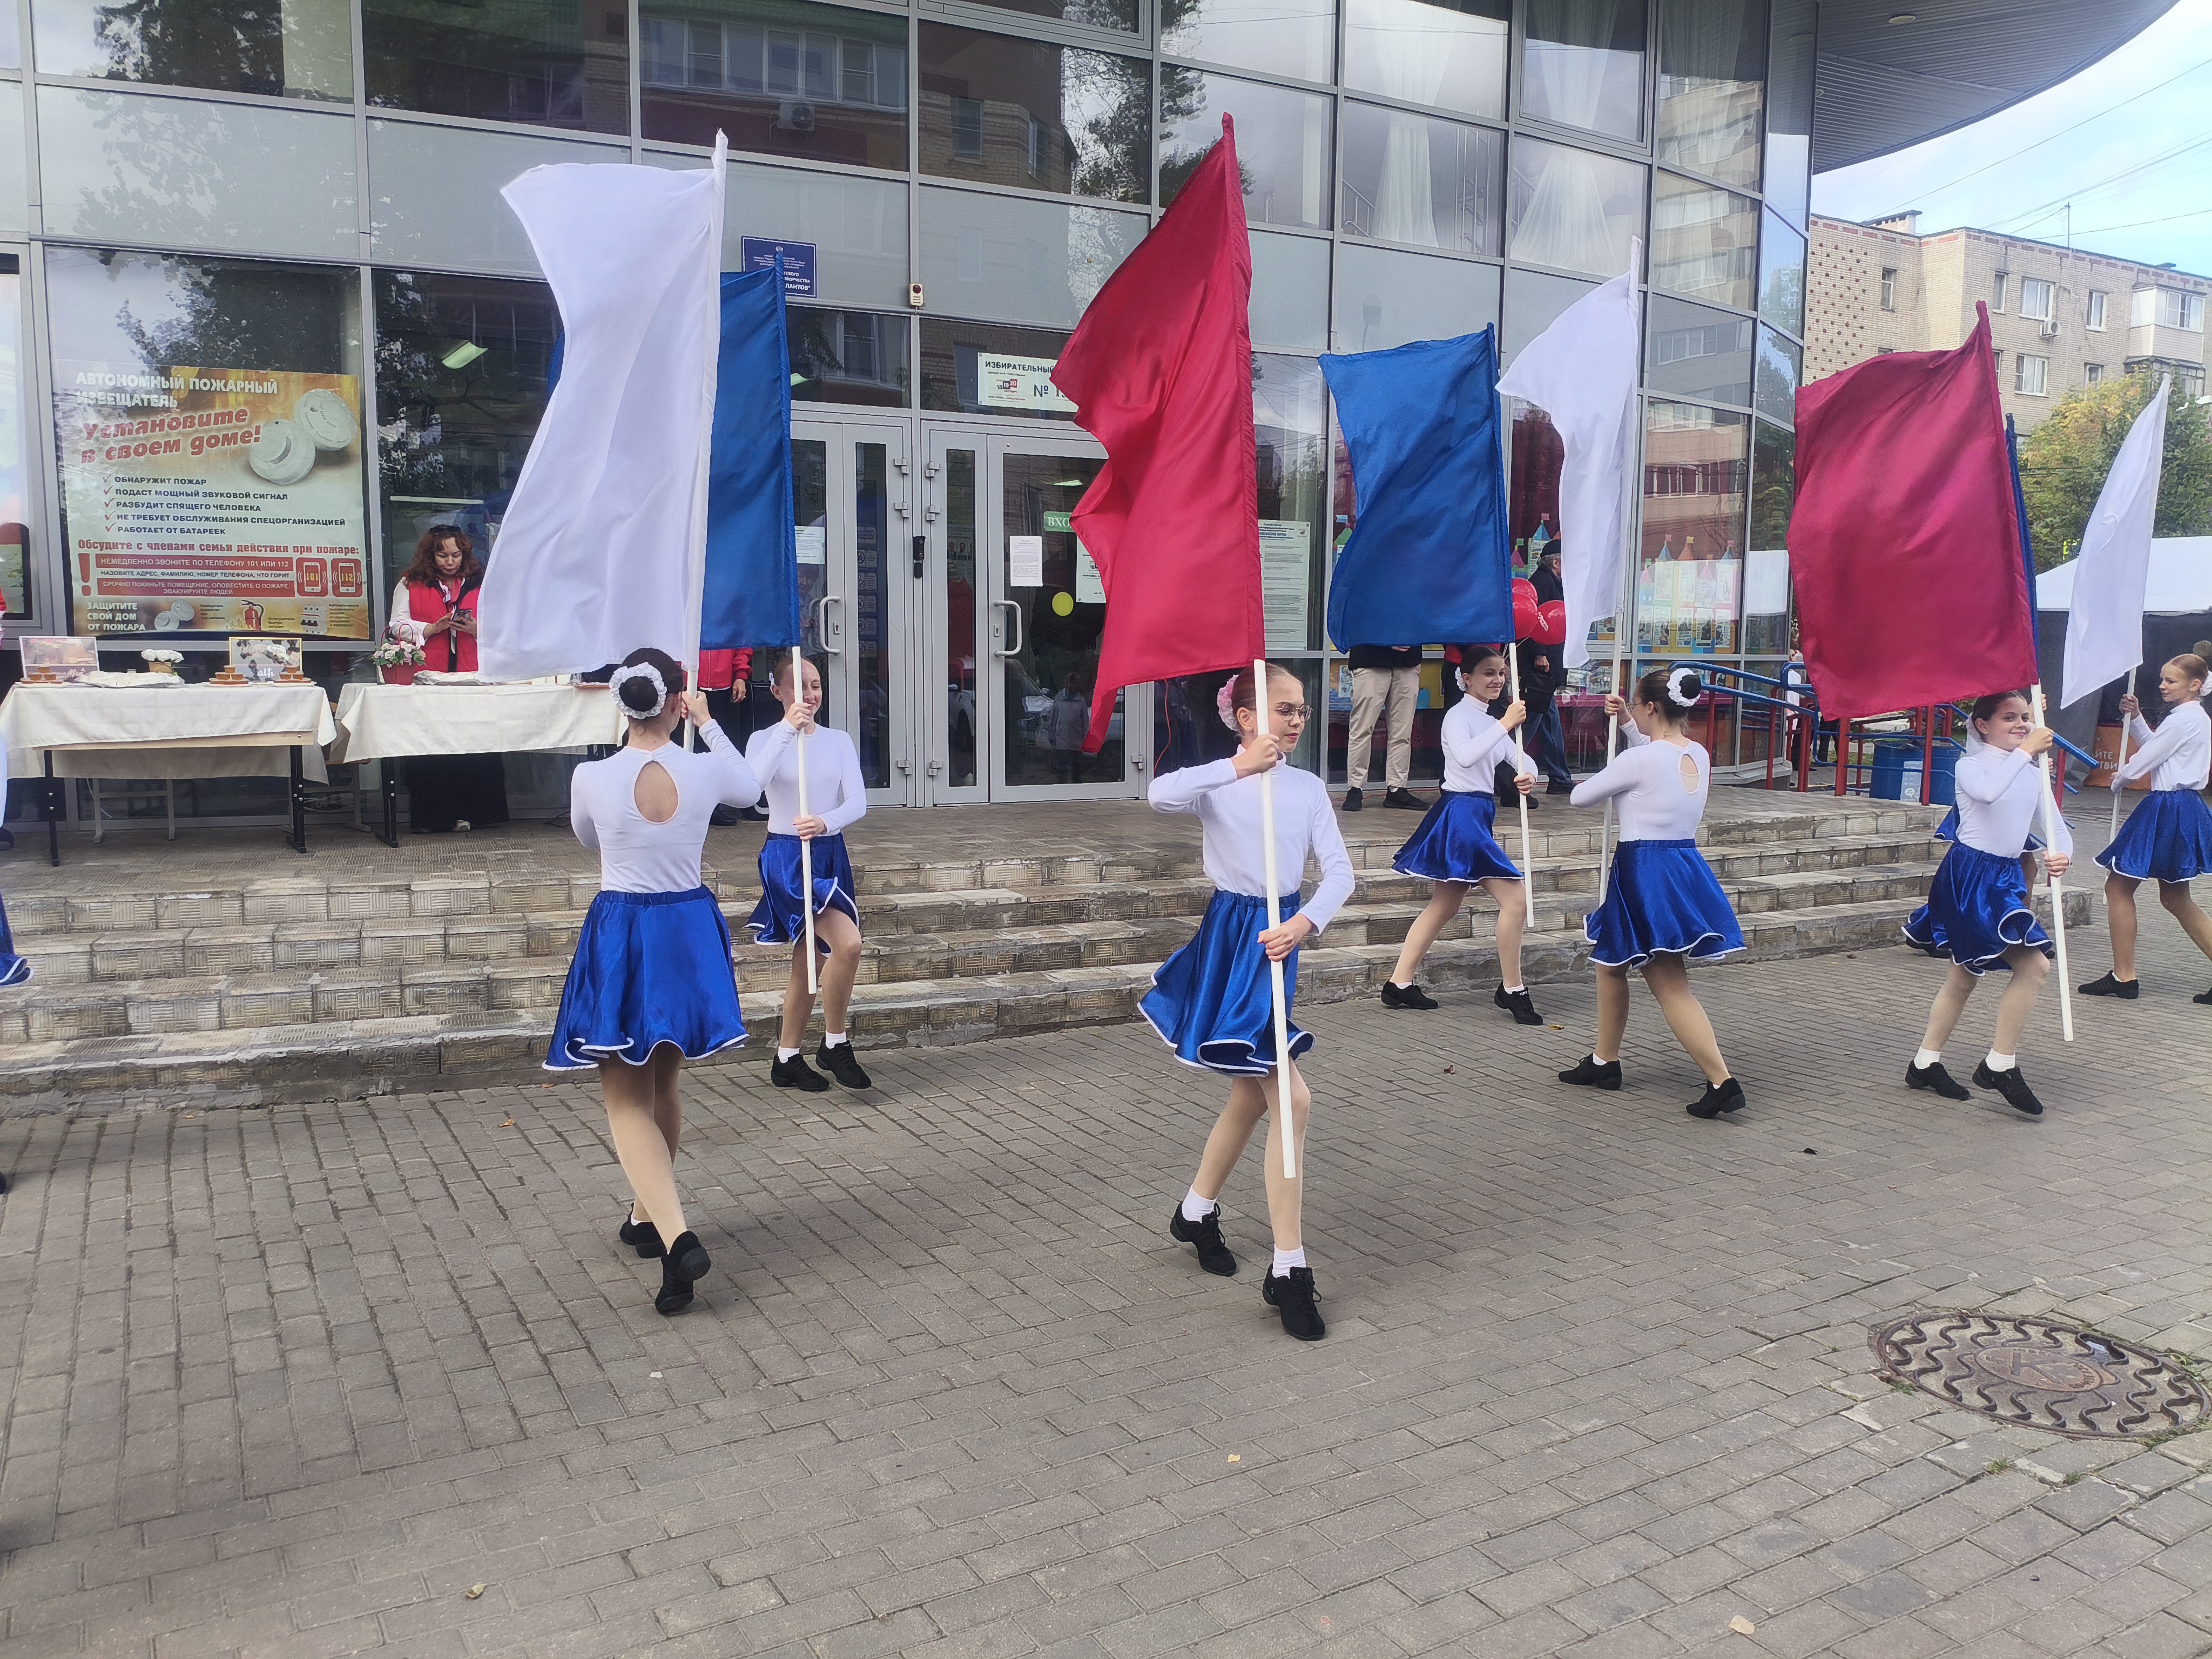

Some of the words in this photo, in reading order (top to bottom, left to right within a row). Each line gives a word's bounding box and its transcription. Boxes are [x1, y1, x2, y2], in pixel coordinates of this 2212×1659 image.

[76, 372, 184, 390] АВТОНОМНЫЙ
[190, 379, 278, 394] ПОЖАРНЫЙ
[77, 392, 178, 408] ИЗВЕЩАТЕЛЬ
[83, 409, 248, 440] Установите
[81, 448, 96, 463] в
[105, 439, 181, 461] своем
[190, 425, 261, 456] доме!
[114, 476, 171, 484] ОБНАРУЖИТ
[155, 490, 200, 498] МОЩНЫЙ
[251, 517, 346, 526] СПЕЦОРГАНИЗАЦИЕЙ
[1048, 517, 1072, 529] ВХО
[78, 539, 132, 551] Обсудите
[147, 543, 195, 551] членами
[199, 543, 232, 551] семьи
[237, 543, 288, 553] действия
[293, 545, 312, 555] при
[316, 546, 360, 556] пожаре:
[306, 572, 319, 581] 101
[341, 572, 353, 581] 112
[87, 602, 138, 610] ЗАЩИТИТЕ
[87, 611, 112, 621] СВОЙ
